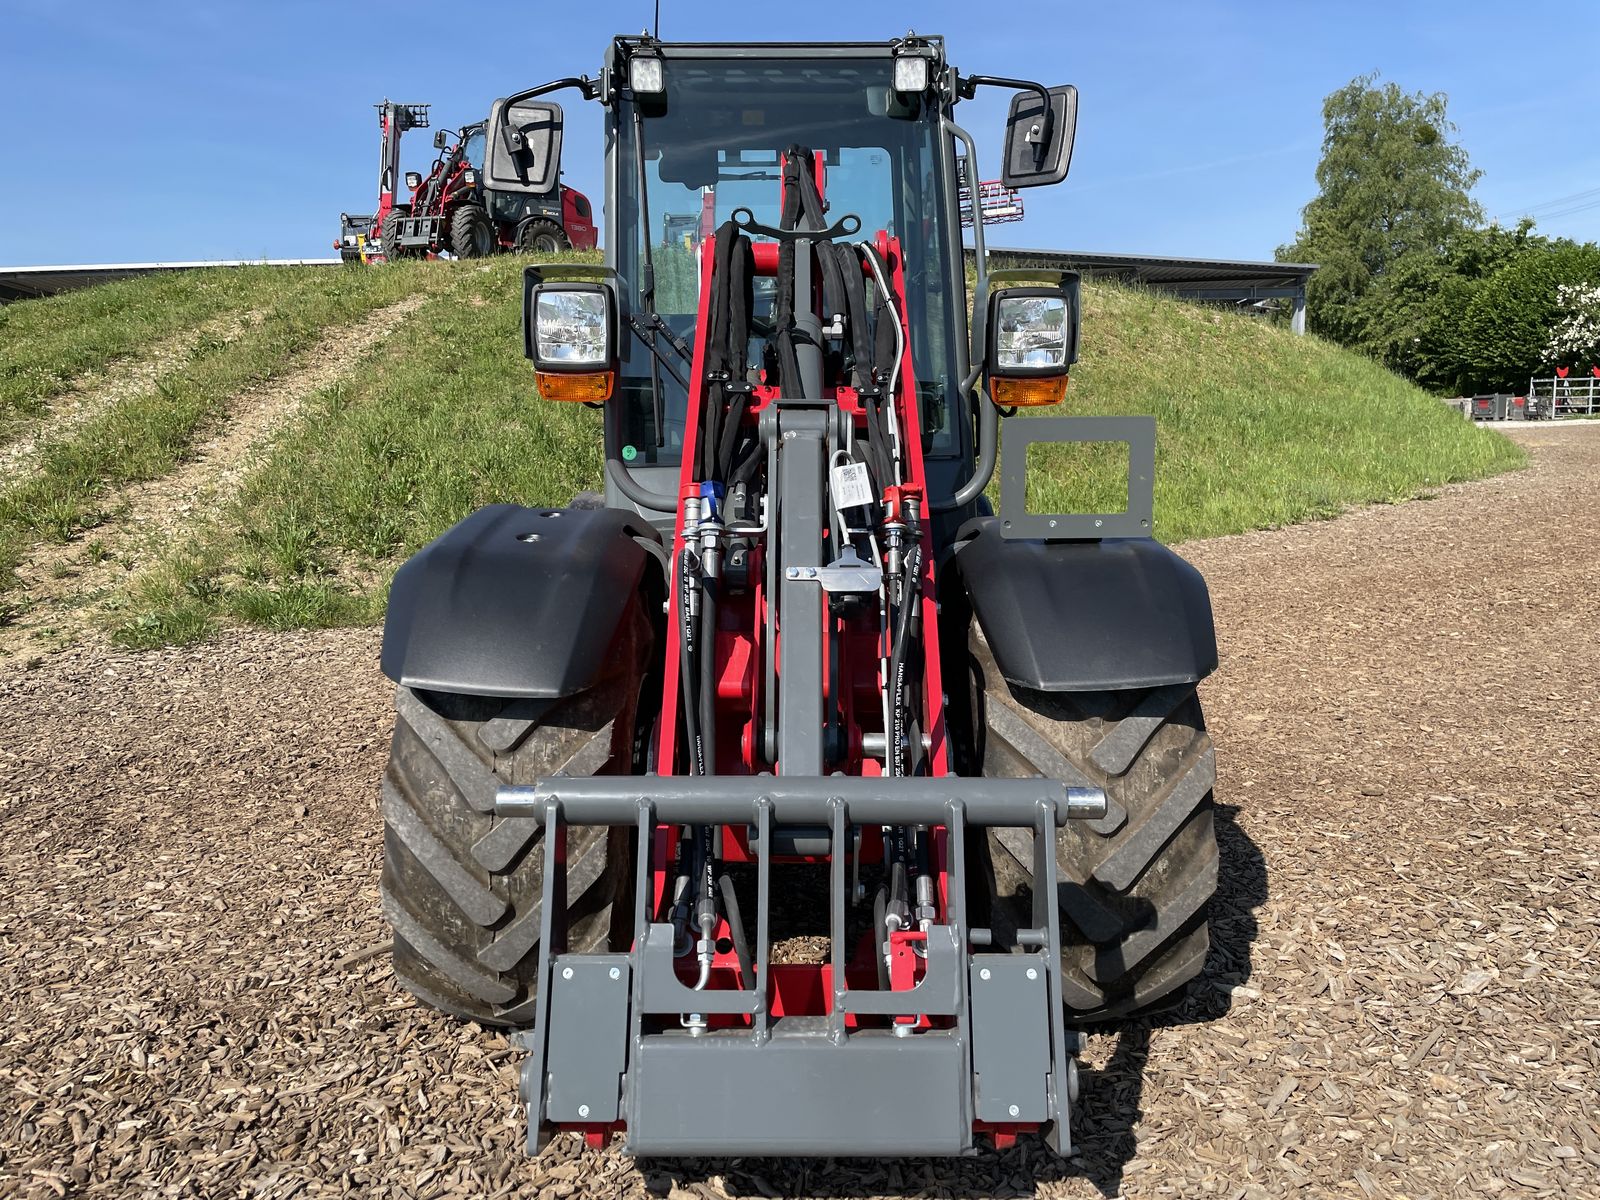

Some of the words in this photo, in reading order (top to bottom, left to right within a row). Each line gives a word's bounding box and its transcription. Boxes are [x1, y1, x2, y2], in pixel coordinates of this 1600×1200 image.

[895, 662, 904, 706] HANSA-FLEX
[894, 709, 901, 718] KP
[894, 746, 901, 755] EN
